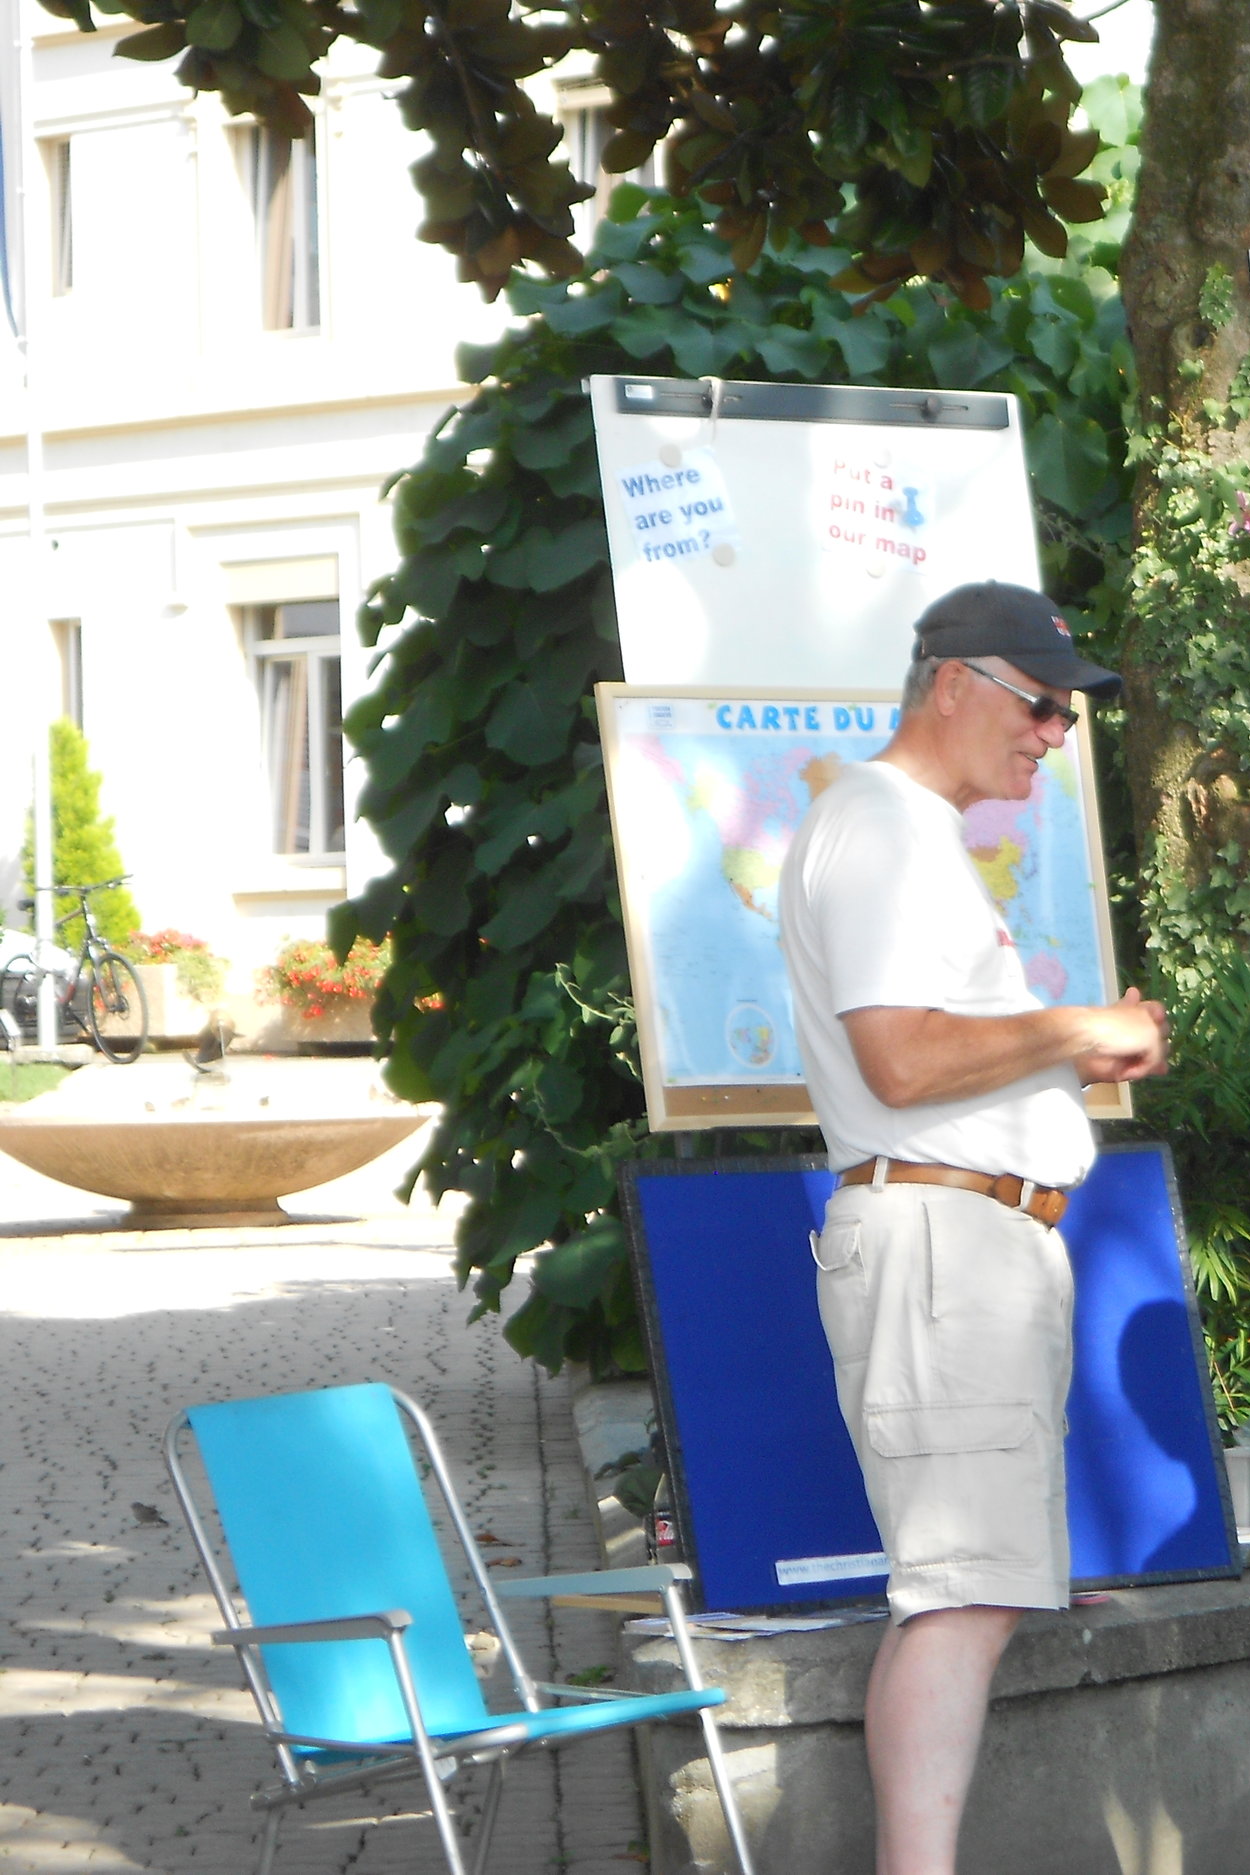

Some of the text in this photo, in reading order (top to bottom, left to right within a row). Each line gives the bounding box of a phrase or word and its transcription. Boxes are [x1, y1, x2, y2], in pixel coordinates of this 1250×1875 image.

[621, 469, 701, 498] Where
[833, 458, 893, 491] Put a
[635, 496, 724, 530] are you
[830, 494, 895, 522] pin in
[643, 528, 711, 562] from?
[829, 524, 927, 566] our map
[716, 704, 821, 731] CARTE
[832, 706, 876, 732] DU
